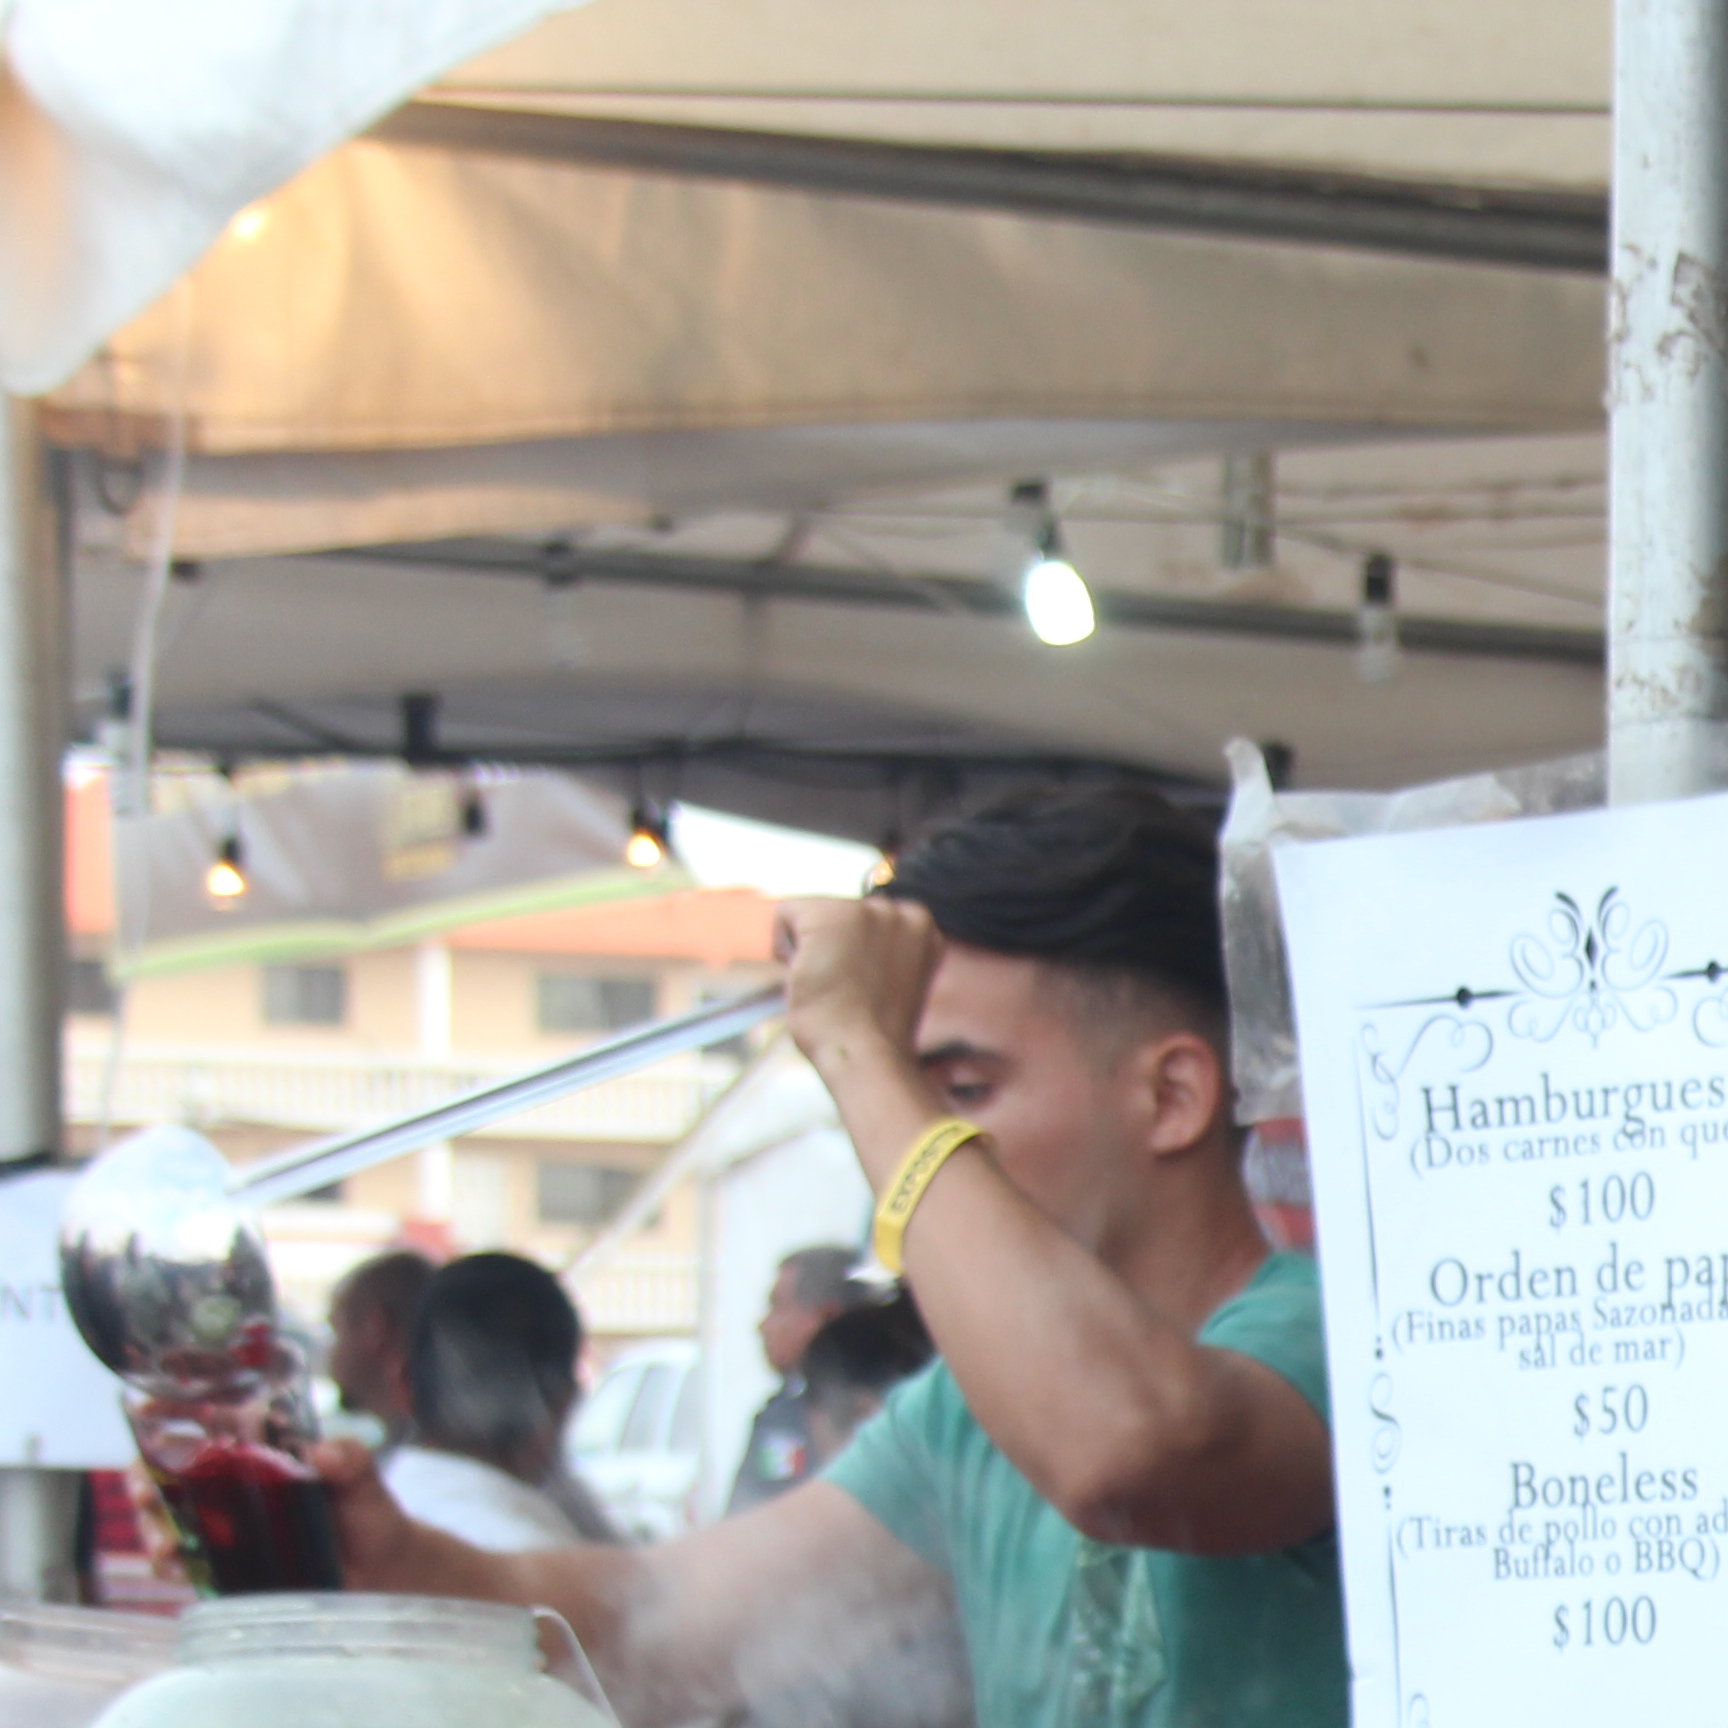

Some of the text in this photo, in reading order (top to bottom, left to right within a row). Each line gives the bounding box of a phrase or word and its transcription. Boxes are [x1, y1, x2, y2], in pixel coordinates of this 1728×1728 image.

[1409, 1133, 1491, 1181] (Dos
[1503, 1132, 1601, 1163] carnes
[1613, 1125, 1667, 1154] con
[1548, 1170, 1656, 1232] $100
[1429, 1249, 1579, 1307] Orden
[1596, 1241, 1646, 1295] de
[1391, 1310, 1487, 1354] (Finas
[1497, 1309, 1582, 1352] papas
[1518, 1327, 1687, 1371] sal de mar)
[1573, 1383, 1650, 1438] $50
[1510, 1451, 1700, 1510] Boneless
[1395, 1516, 1488, 1559] (Tiras
[1498, 1508, 1534, 1546] de
[1544, 1500, 1618, 1560] pollo
[1628, 1513, 1682, 1540] con
[1493, 1536, 1721, 1582] Buffalo o BBQ)
[1552, 1594, 1658, 1651] $100
